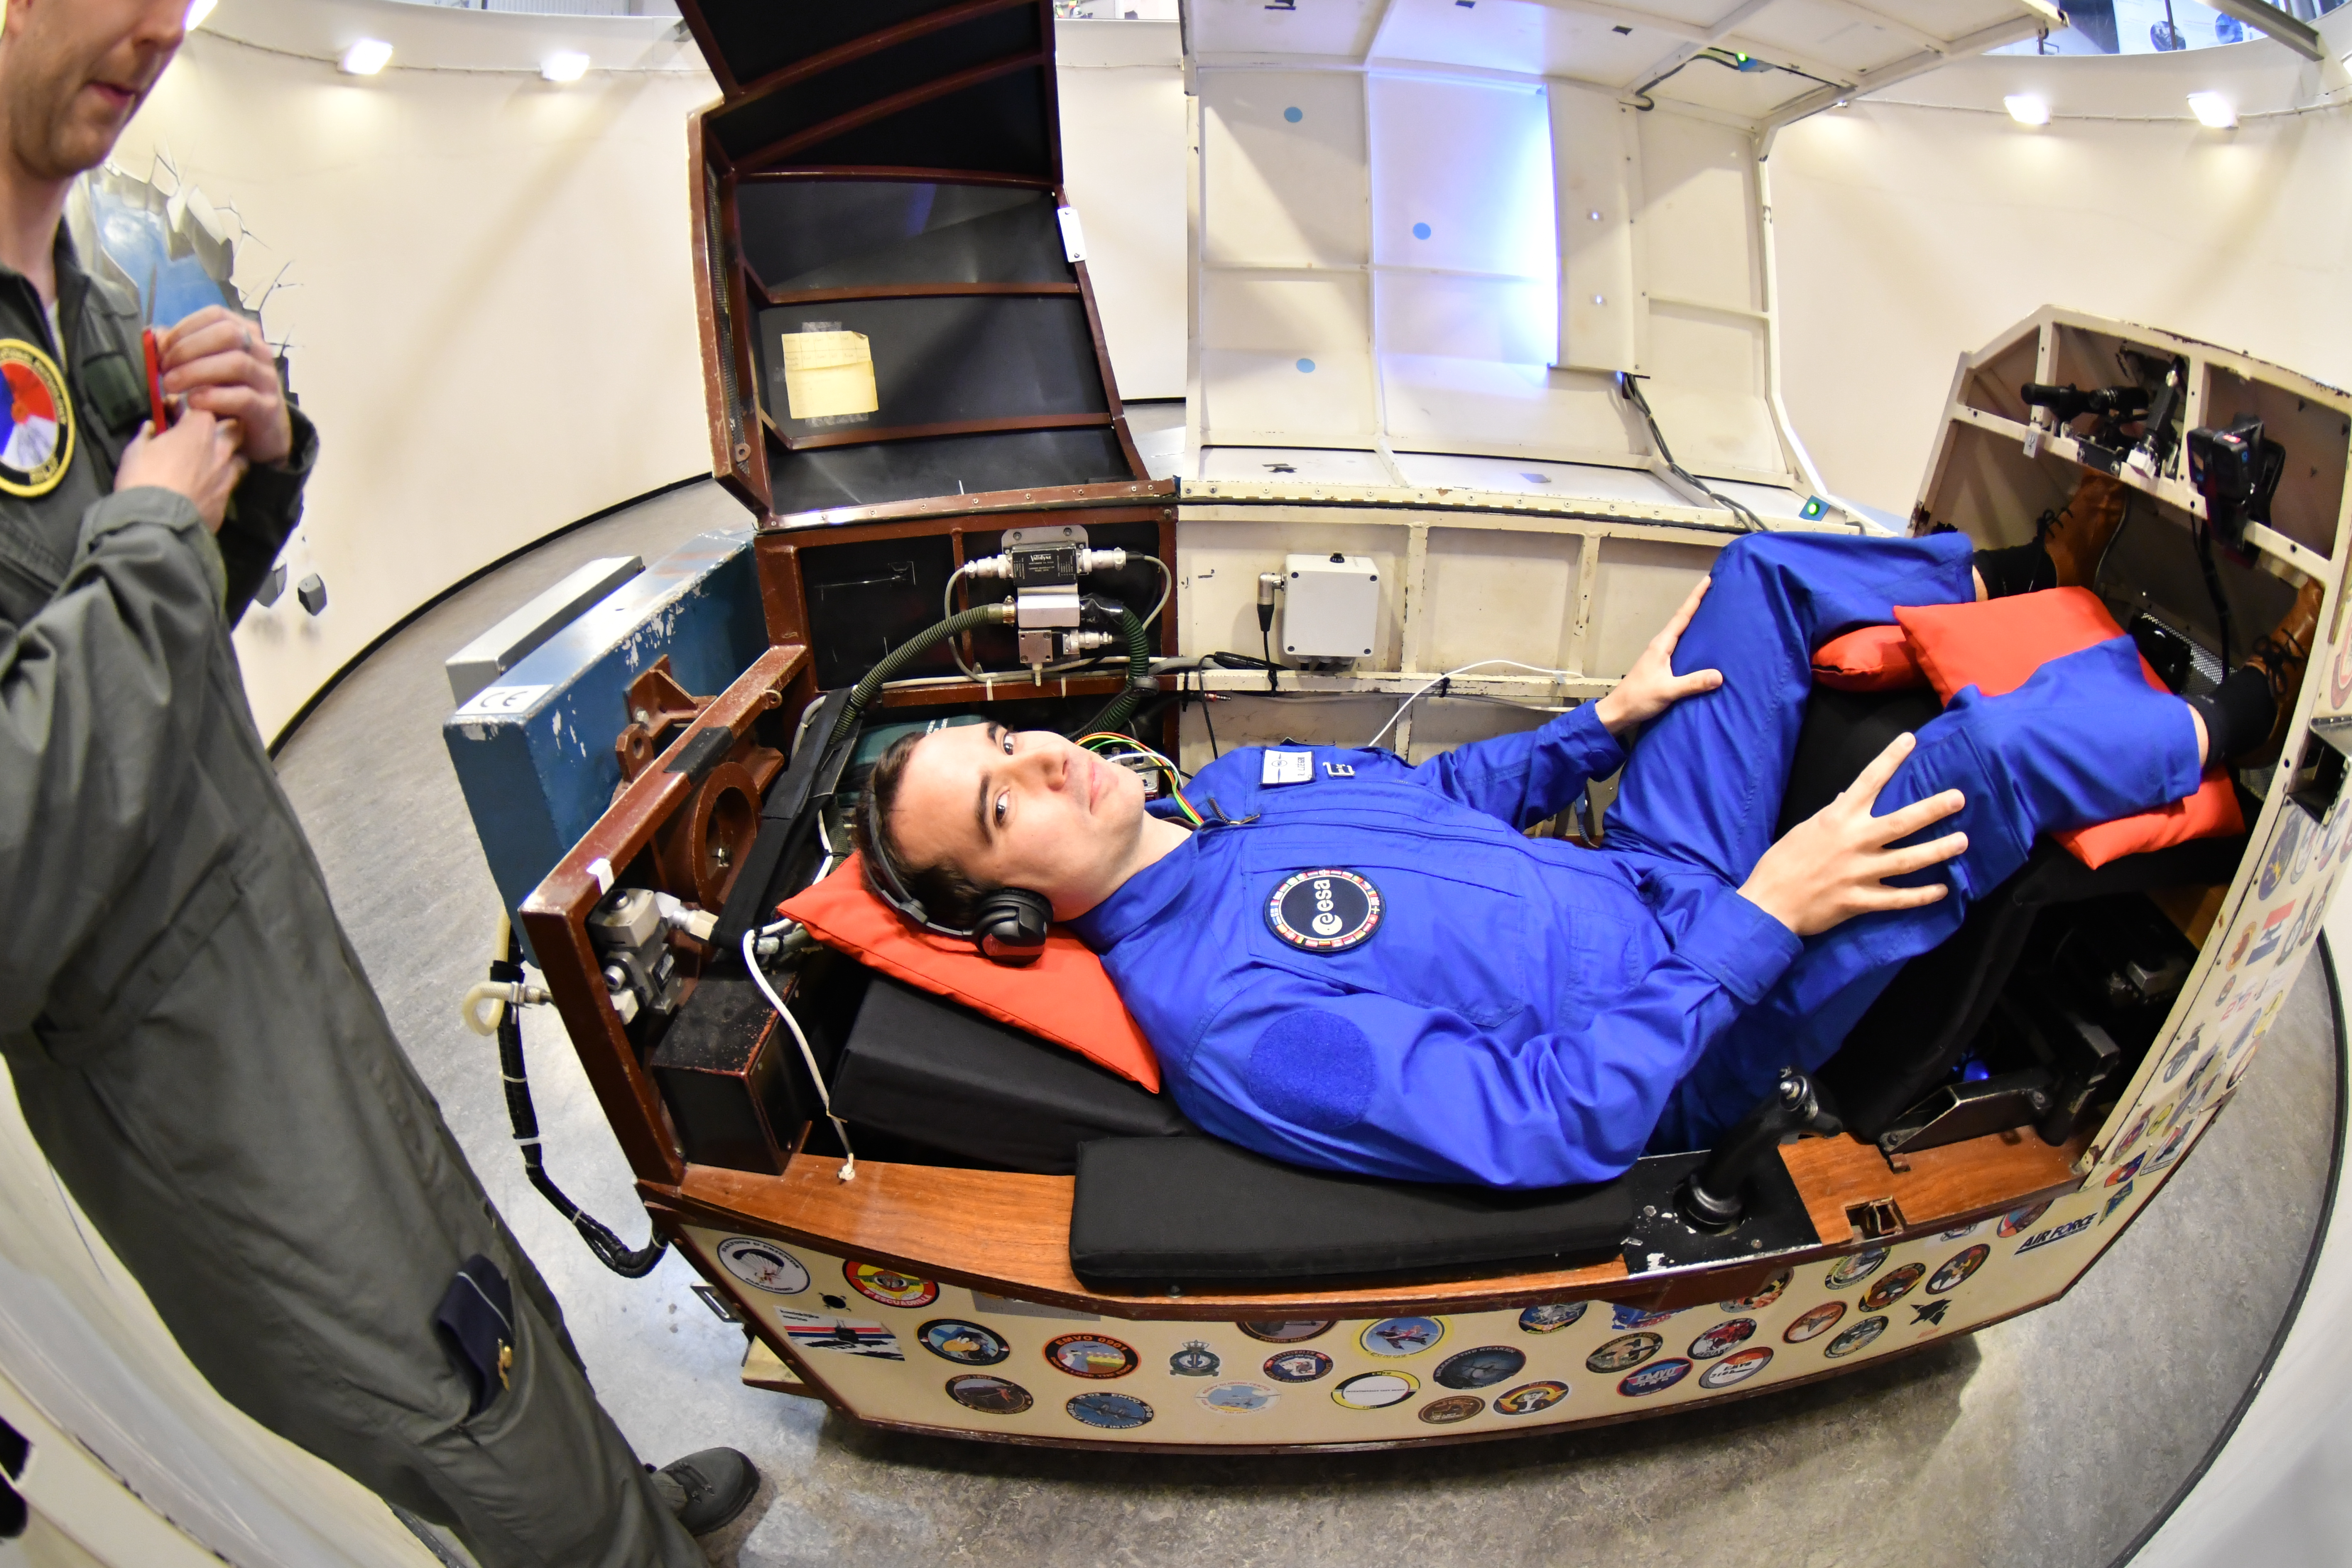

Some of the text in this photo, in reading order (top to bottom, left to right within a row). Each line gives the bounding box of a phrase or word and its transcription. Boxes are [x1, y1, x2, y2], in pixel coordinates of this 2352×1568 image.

[1314, 879, 1334, 912] esa
[2019, 1230, 2052, 1250] AIR
[2049, 1212, 2098, 1239] FORCE
[1055, 1335, 1128, 1351] EMVO 0901
[1637, 1367, 1677, 1381] EMVO
[1111, 1393, 1141, 1404] EMVO
[1083, 1420, 1106, 1428] THAT
